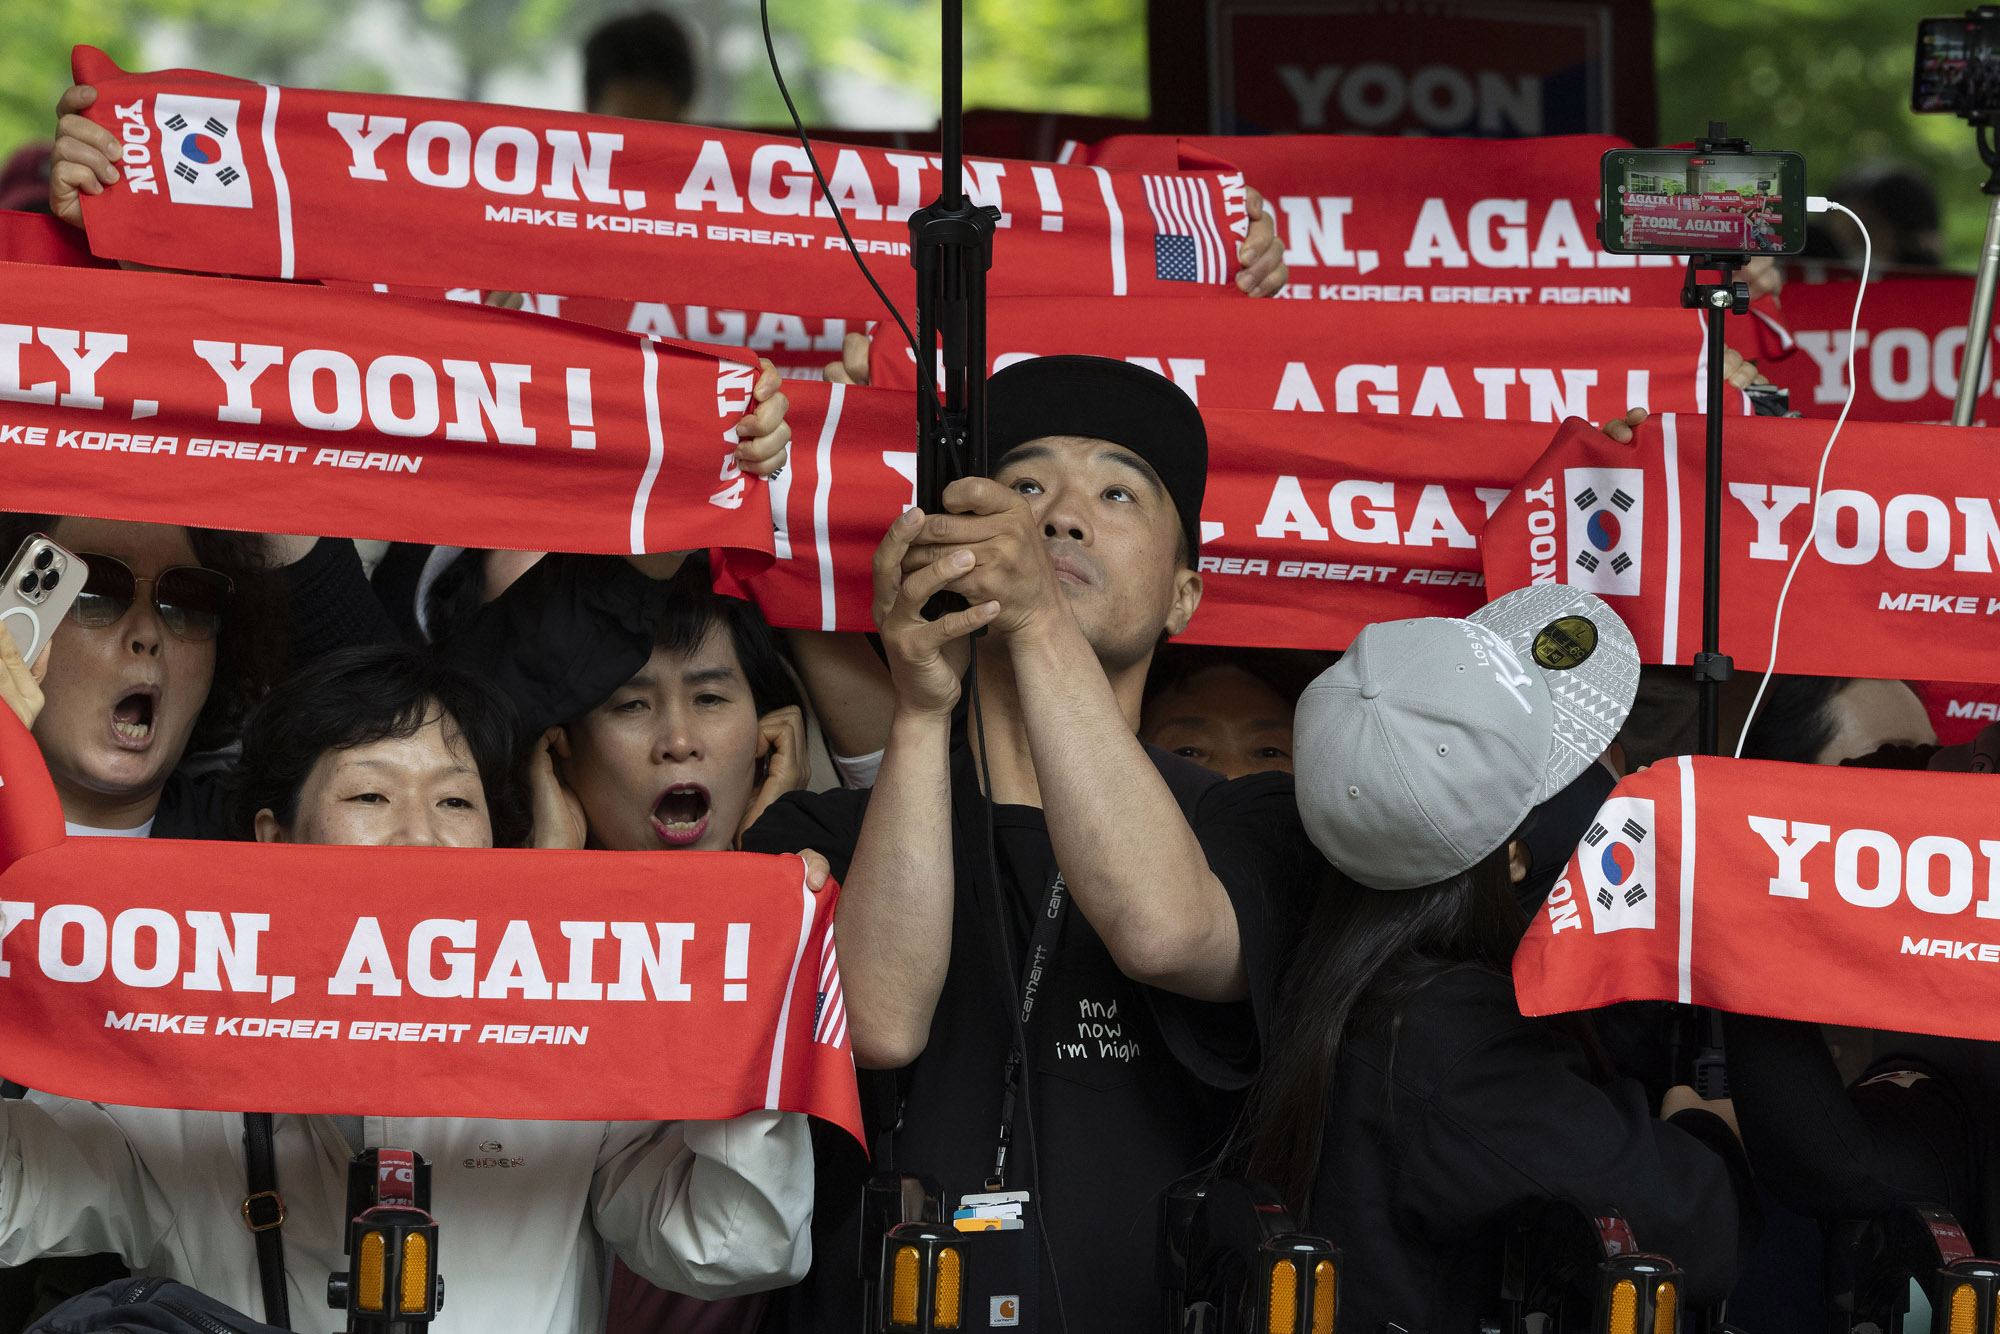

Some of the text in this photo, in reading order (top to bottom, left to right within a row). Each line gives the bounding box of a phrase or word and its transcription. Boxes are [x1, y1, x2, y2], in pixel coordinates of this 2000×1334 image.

[1277, 63, 1543, 135] YOON
[114, 99, 159, 195] YOON
[327, 111, 647, 211] YOON,
[485, 205, 577, 228] MAKE
[587, 214, 698, 238] KOREA
[707, 226, 814, 248] GREAT
[1319, 285, 1424, 302] KOREA
[1431, 287, 1532, 303] GREAT
[1540, 287, 1631, 304] AGAIN
[1793, 327, 2000, 405] YOO
[193, 340, 537, 446] YOON
[56, 431, 179, 456] KOREA
[186, 439, 307, 461] GREAT
[313, 449, 423, 473] AGAIN
[1525, 478, 1556, 586] YOON
[1197, 556, 1487, 588] REA GREAT AGAI
[1878, 592, 1979, 614] MAKE
[328, 917, 695, 1001] AGAIN
[1021, 945, 1047, 1023] carhartt
[105, 1011, 589, 1045] MAKE KOREA GREAT AGAIN
[1079, 999, 1117, 1019] And
[1056, 1040, 1140, 1062] i'm high
[1078, 1023, 1122, 1039] now
[462, 1157, 525, 1169] EIDER
